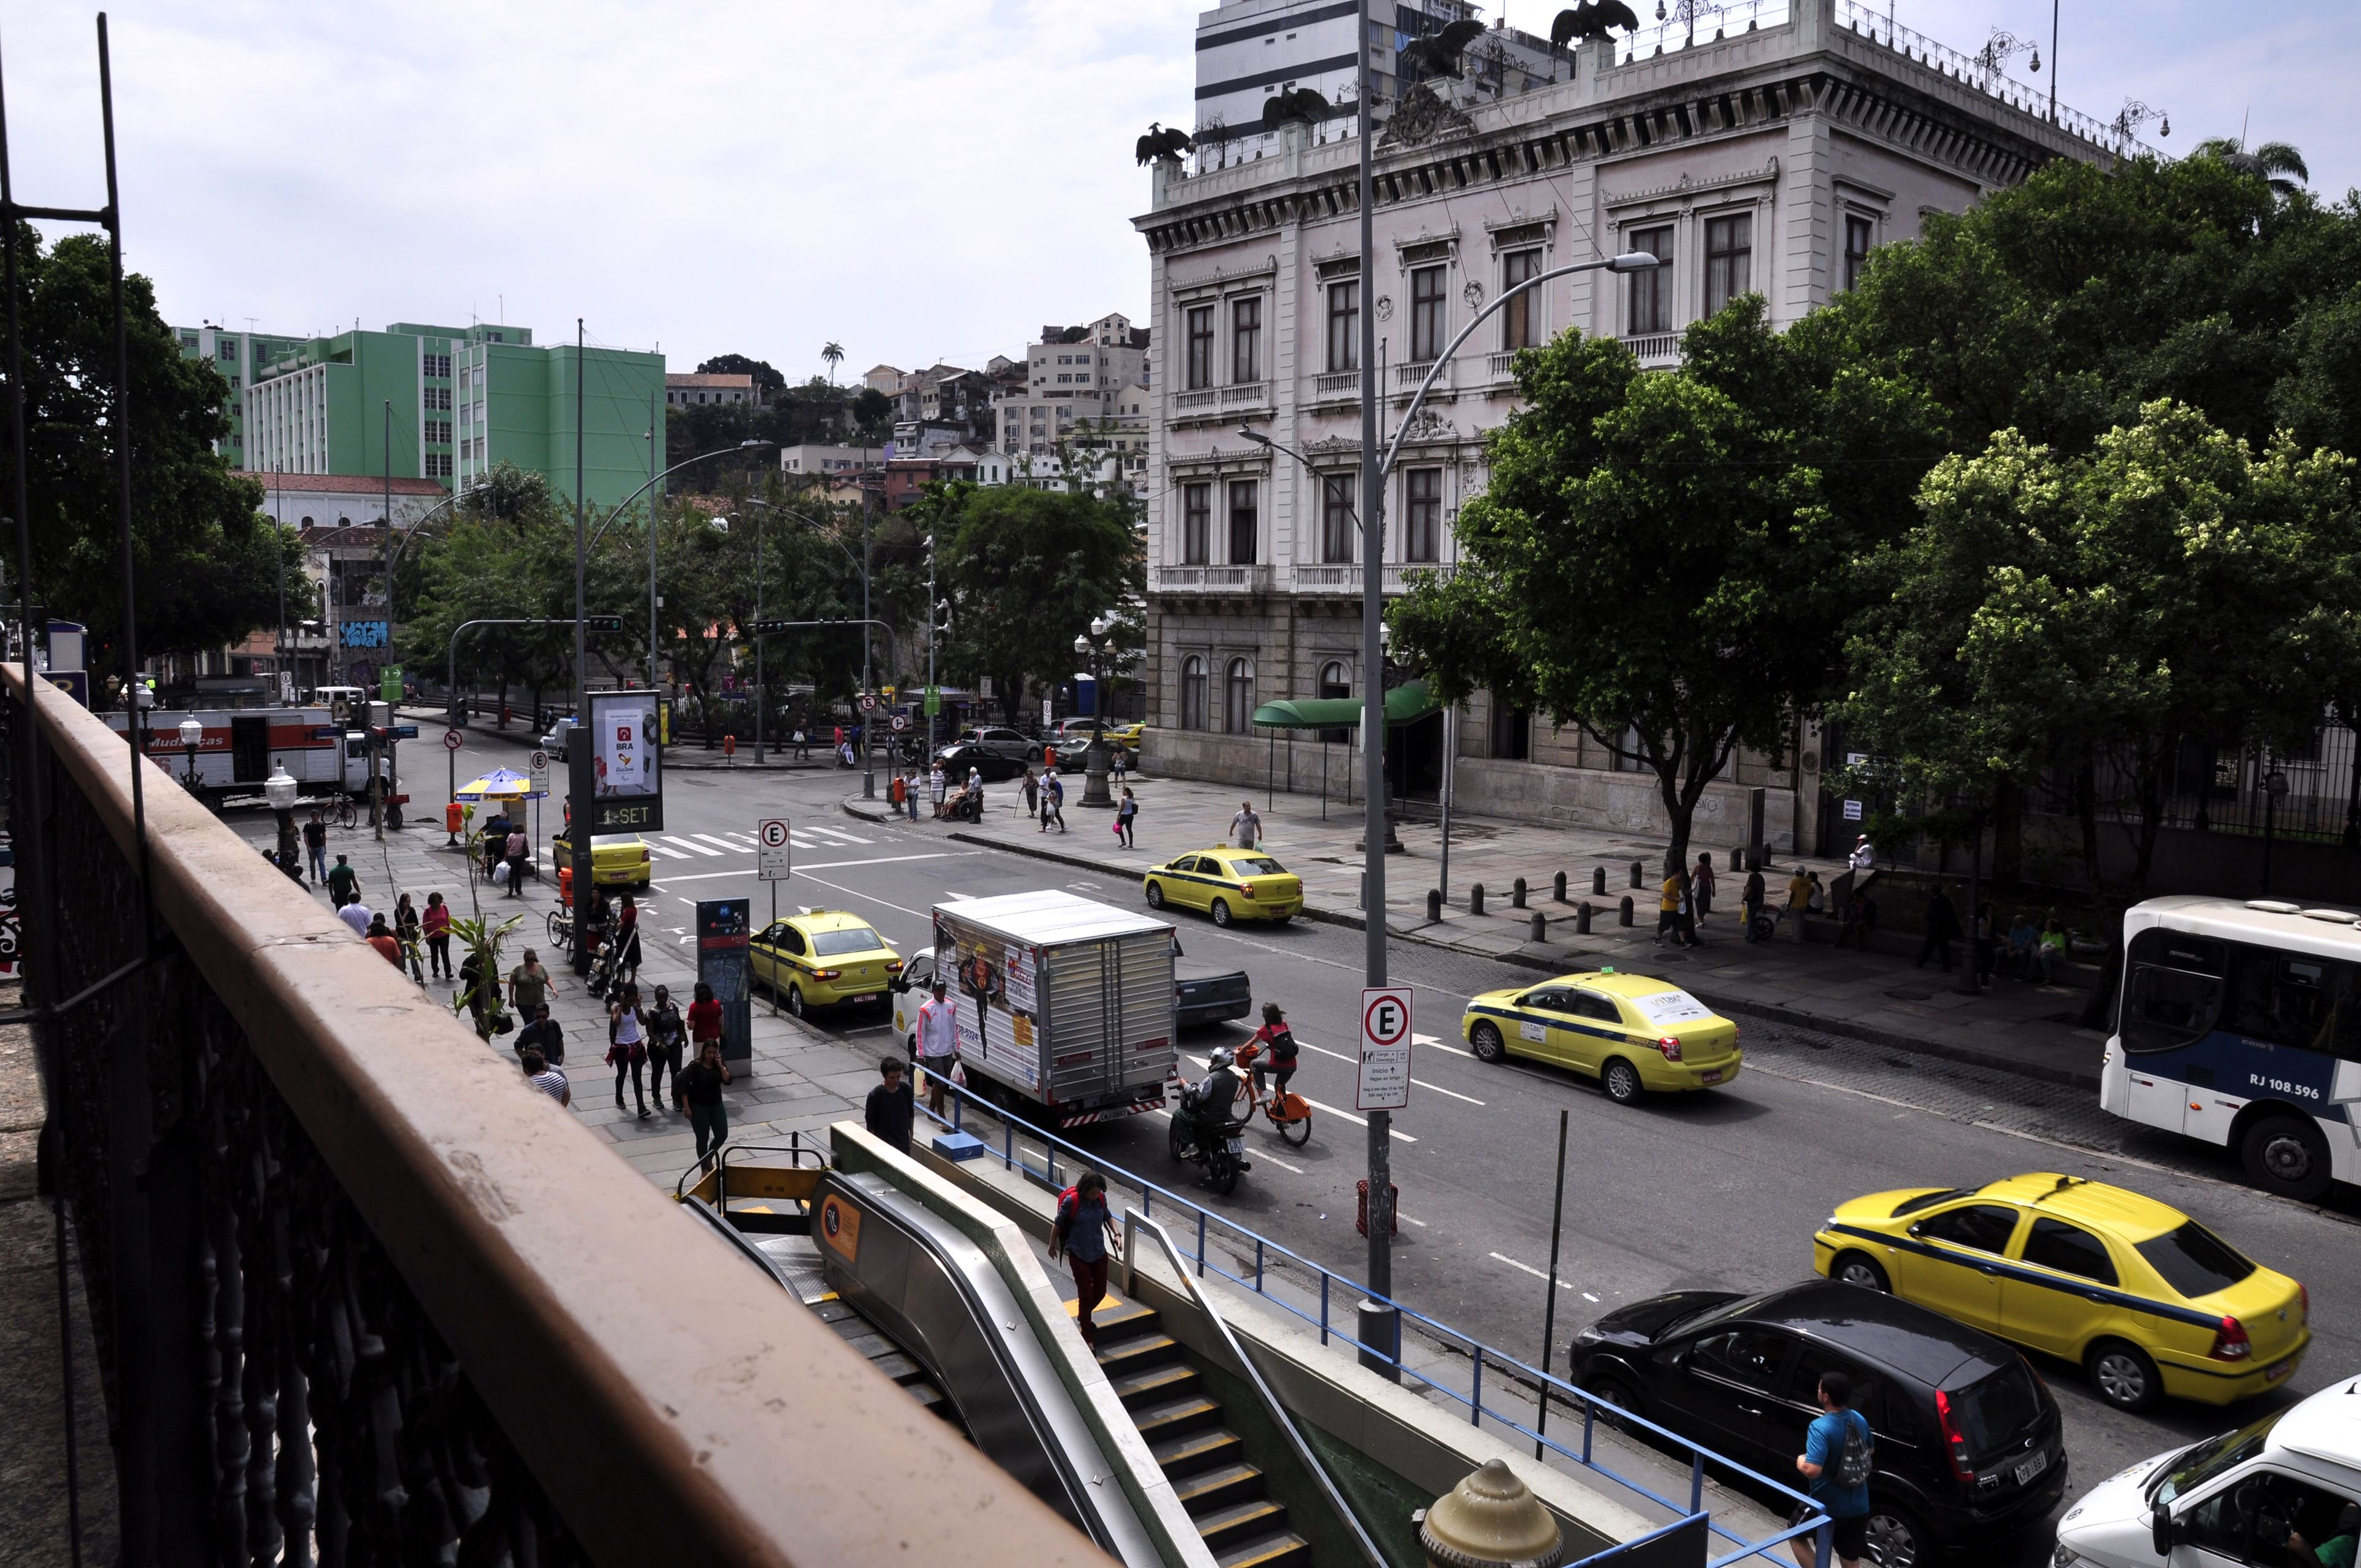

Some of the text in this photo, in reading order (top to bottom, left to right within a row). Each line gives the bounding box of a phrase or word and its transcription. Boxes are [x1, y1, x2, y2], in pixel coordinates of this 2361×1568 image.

[149, 737, 223, 748] Mudaças
[537, 755, 542, 766] E
[604, 807, 649, 825] 1-SET
[770, 827, 779, 842] E
[1379, 1006, 1394, 1035] E
[2250, 1074, 2320, 1099] RJ 108.596
